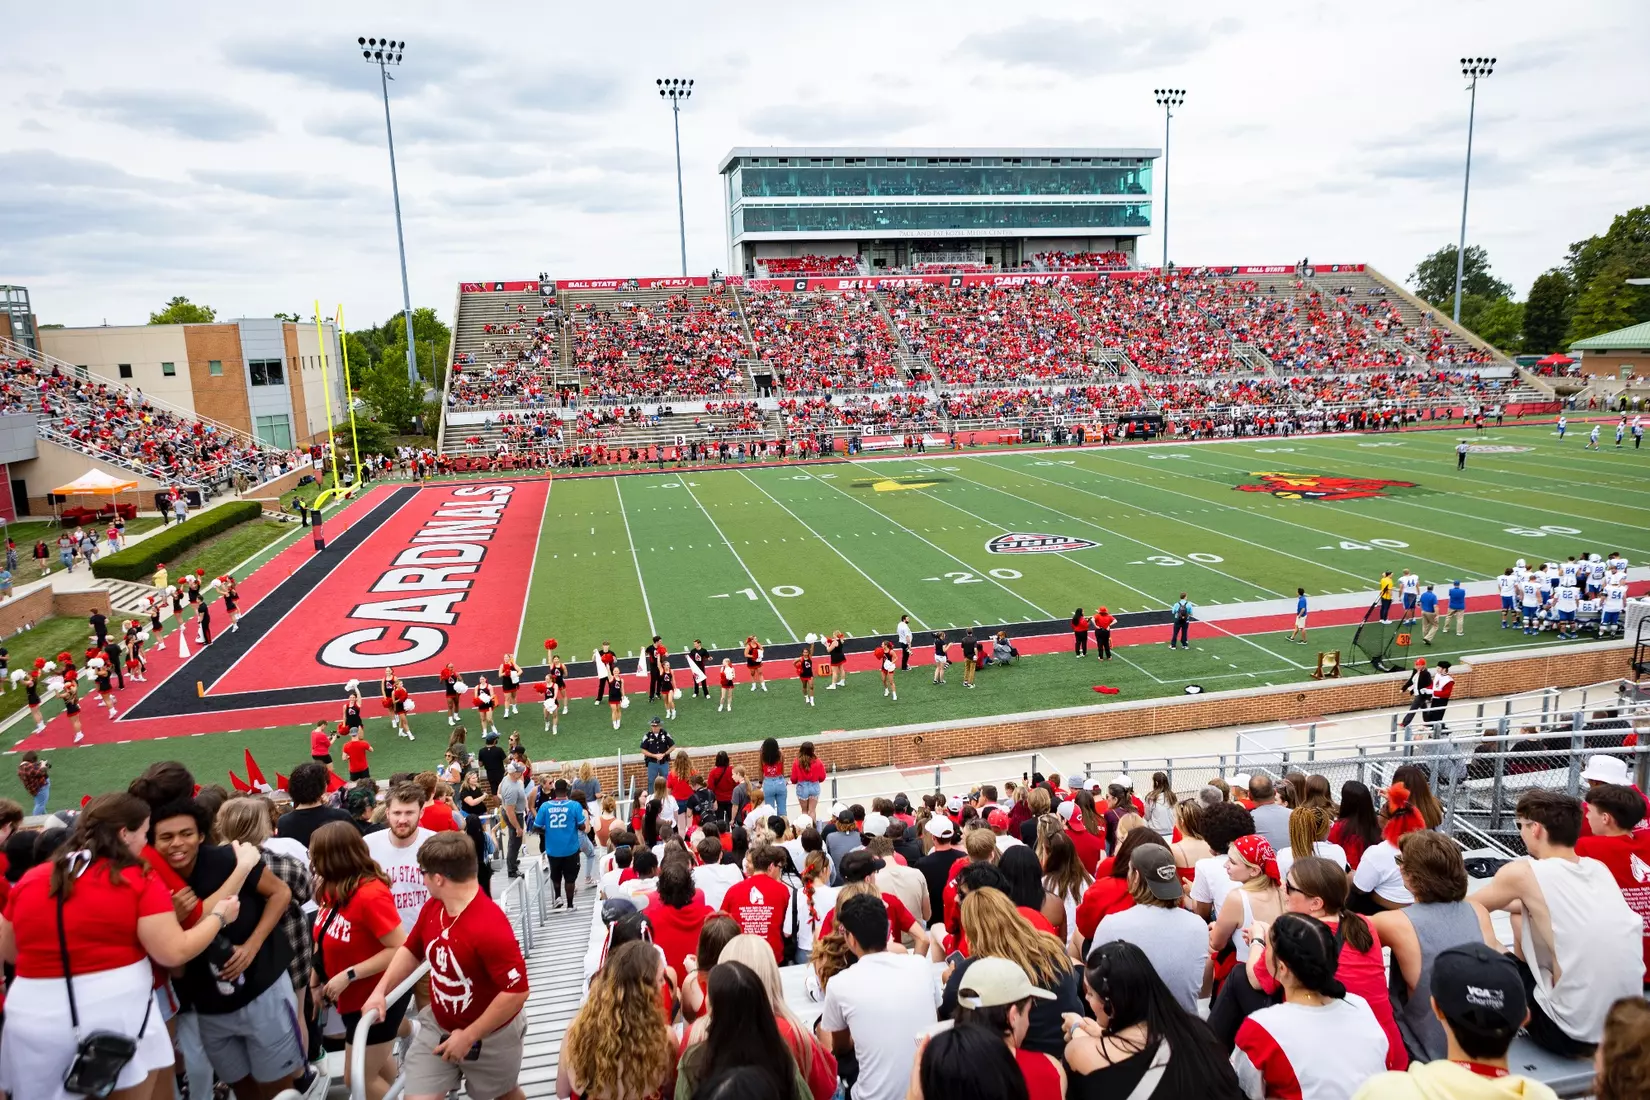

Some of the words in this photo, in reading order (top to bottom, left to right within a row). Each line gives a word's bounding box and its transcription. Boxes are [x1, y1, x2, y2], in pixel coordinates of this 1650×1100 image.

[796, 280, 806, 289] C
[951, 278, 961, 286] D
[1055, 416, 1063, 425] D
[865, 426, 872, 435] C
[676, 436, 684, 445] B
[1503, 525, 1583, 538] 50
[1338, 538, 1410, 552] 40
[1146, 552, 1225, 567] 30
[1565, 567, 1575, 575] 84
[315, 485, 515, 669] CARDINALS
[944, 568, 1024, 585] 20
[1406, 579, 1416, 588] 44
[735, 585, 805, 601] 10
[1562, 590, 1573, 599] 62
[1611, 590, 1622, 599] 54
[1400, 635, 1410, 645] 30
[820, 664, 830, 675] 10
[549, 813, 568, 829] 22
[399, 866, 425, 886] STAT
[393, 889, 428, 909] ERSITY
